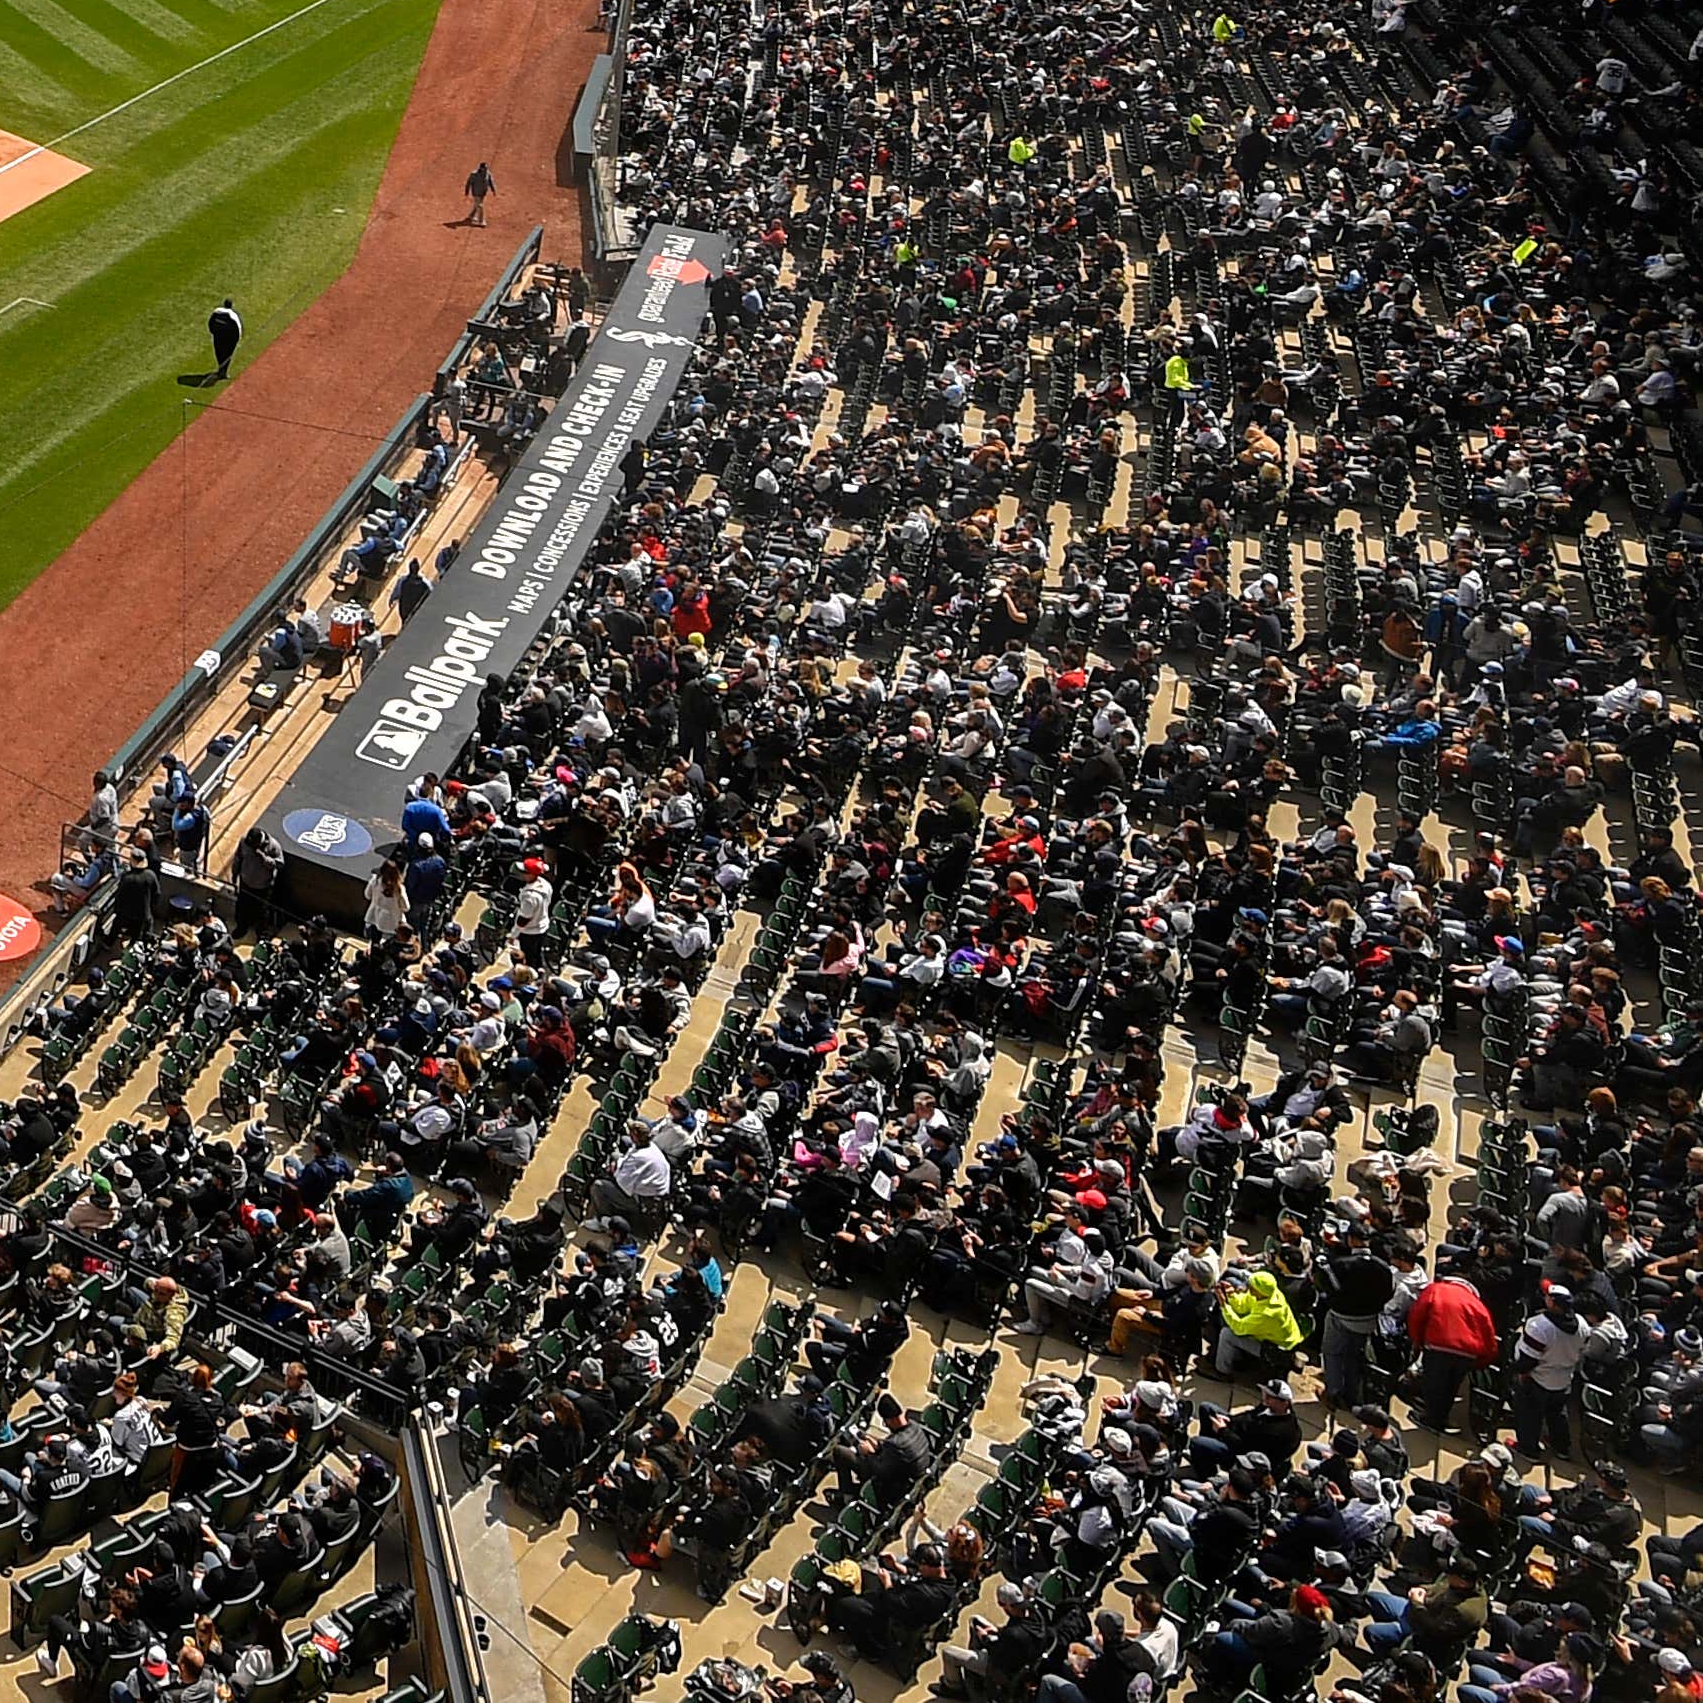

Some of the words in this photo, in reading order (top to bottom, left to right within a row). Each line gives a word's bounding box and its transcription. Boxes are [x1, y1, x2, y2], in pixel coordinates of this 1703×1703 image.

[661, 233, 696, 261] Field
[633, 355, 668, 405] UPGRADES
[623, 397, 646, 429] SEAT
[577, 430, 629, 496] EXPERIENCES
[471, 469, 556, 581] DOWNLOAD
[544, 432, 584, 474] AND
[536, 499, 588, 575] CONCESSIONS
[509, 578, 540, 615] MAPS
[88, 1449, 112, 1475] 22
